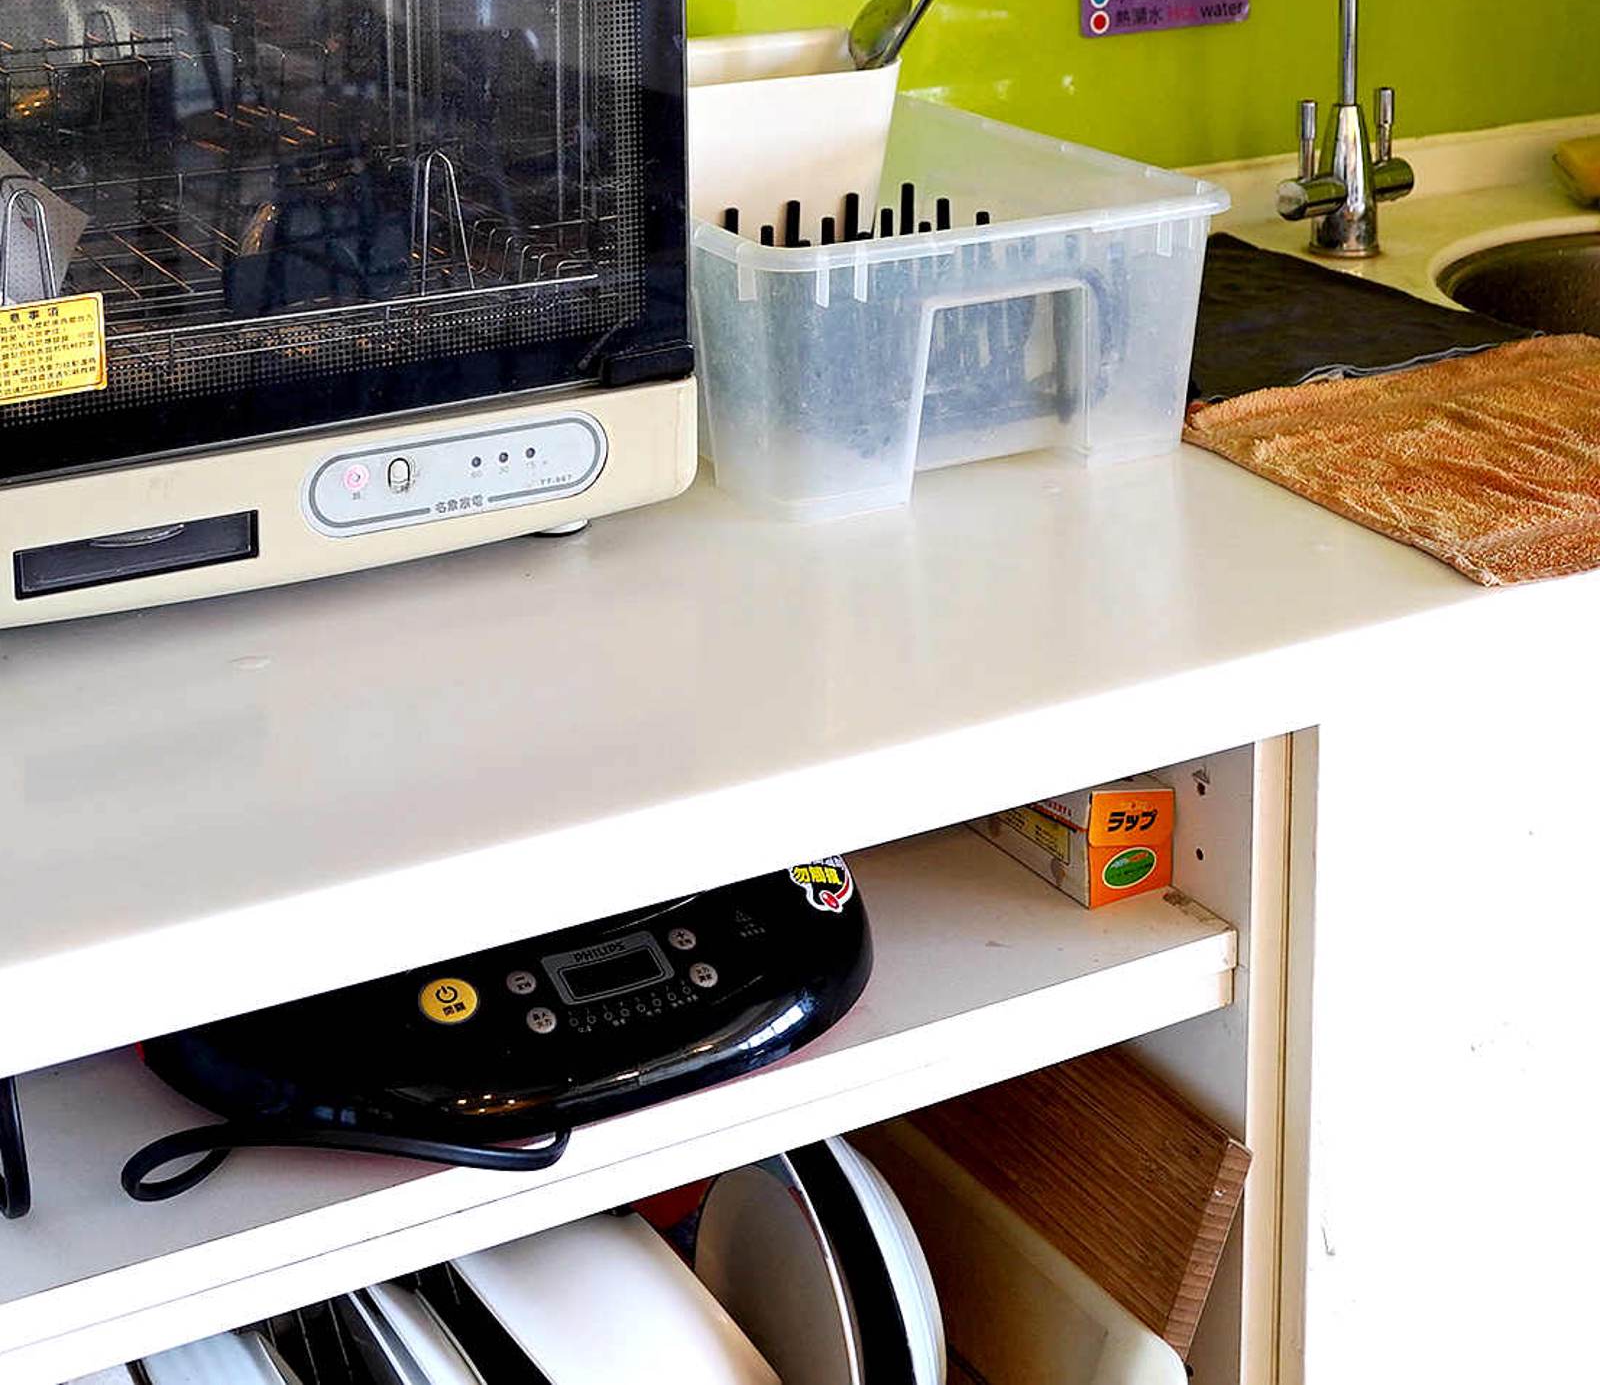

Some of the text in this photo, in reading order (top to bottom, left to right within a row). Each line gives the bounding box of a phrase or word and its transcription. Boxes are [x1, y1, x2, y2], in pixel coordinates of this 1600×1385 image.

[1200, 2, 1244, 19] water
[1107, 809, 1158, 832] ラップ
[573, 941, 627, 963] PHILIPS
